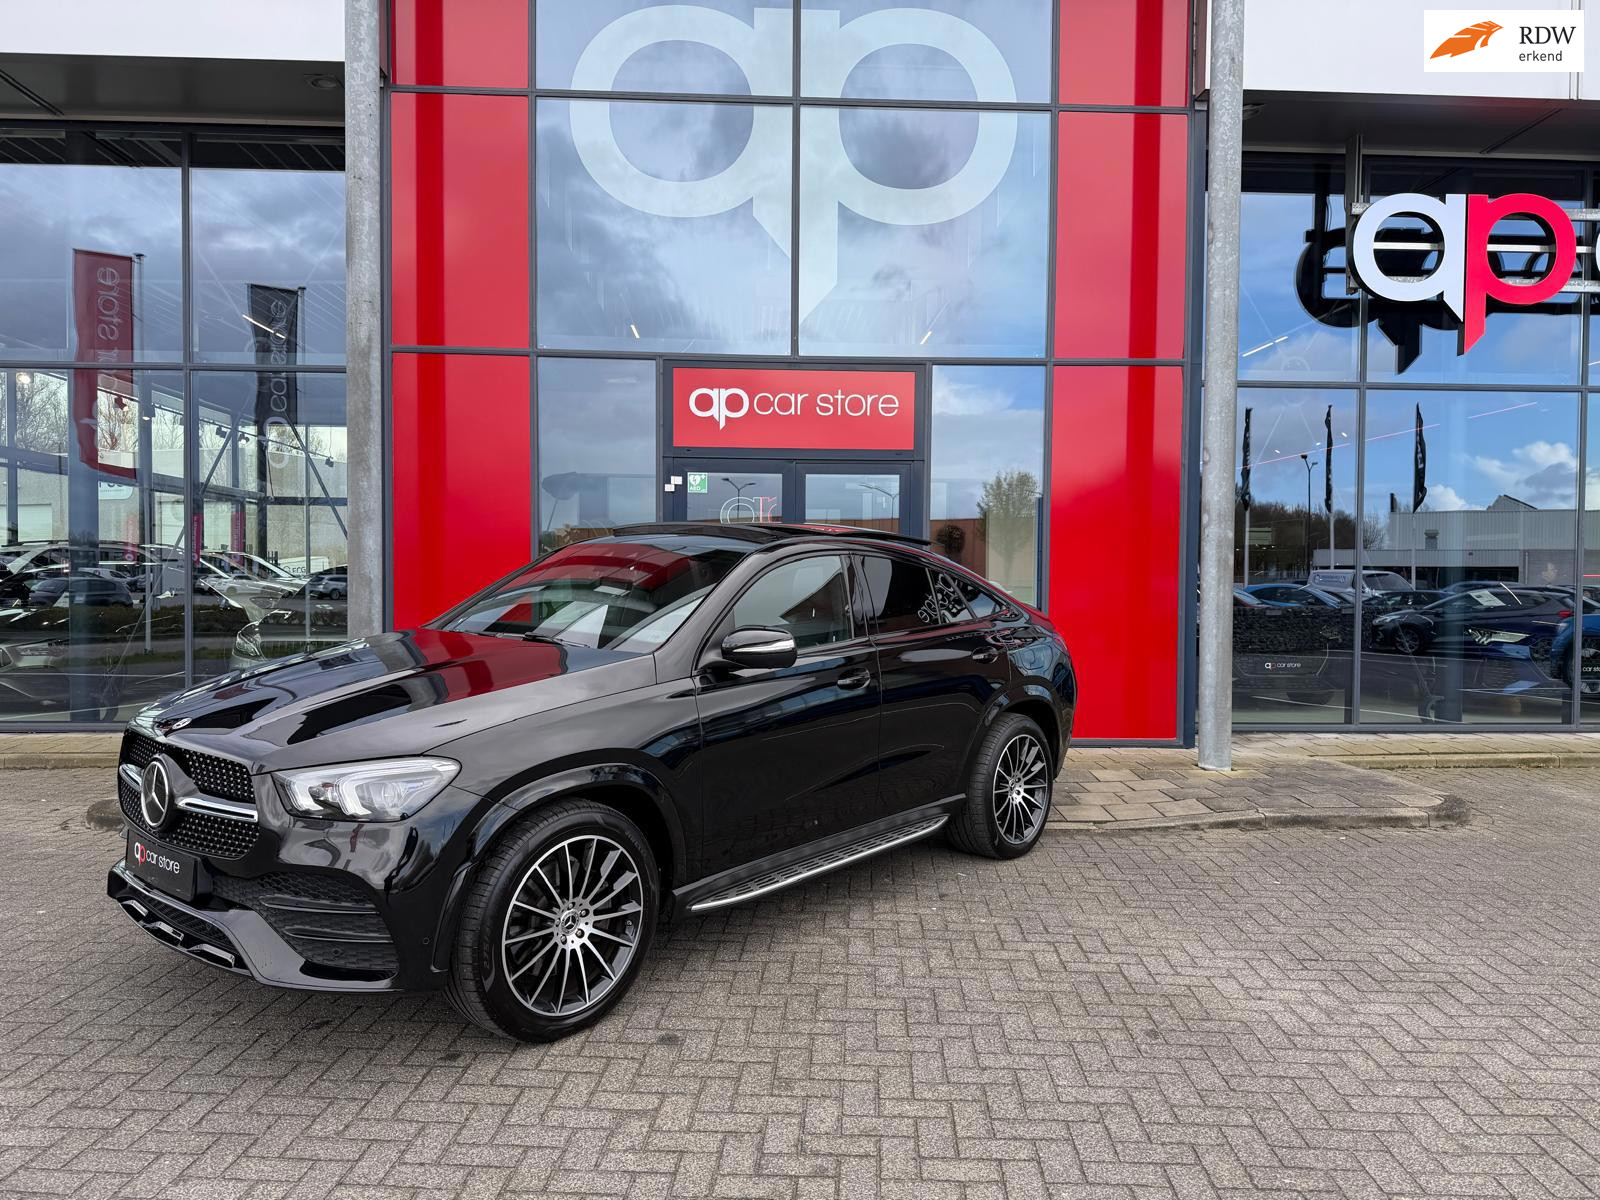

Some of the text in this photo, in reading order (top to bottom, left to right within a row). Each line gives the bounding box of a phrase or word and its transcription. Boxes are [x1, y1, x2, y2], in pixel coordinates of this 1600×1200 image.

[570, 5, 1017, 326] ap
[1353, 193, 1577, 355] ap
[689, 388, 900, 430] ap car store
[134, 842, 180, 873] ap car store
